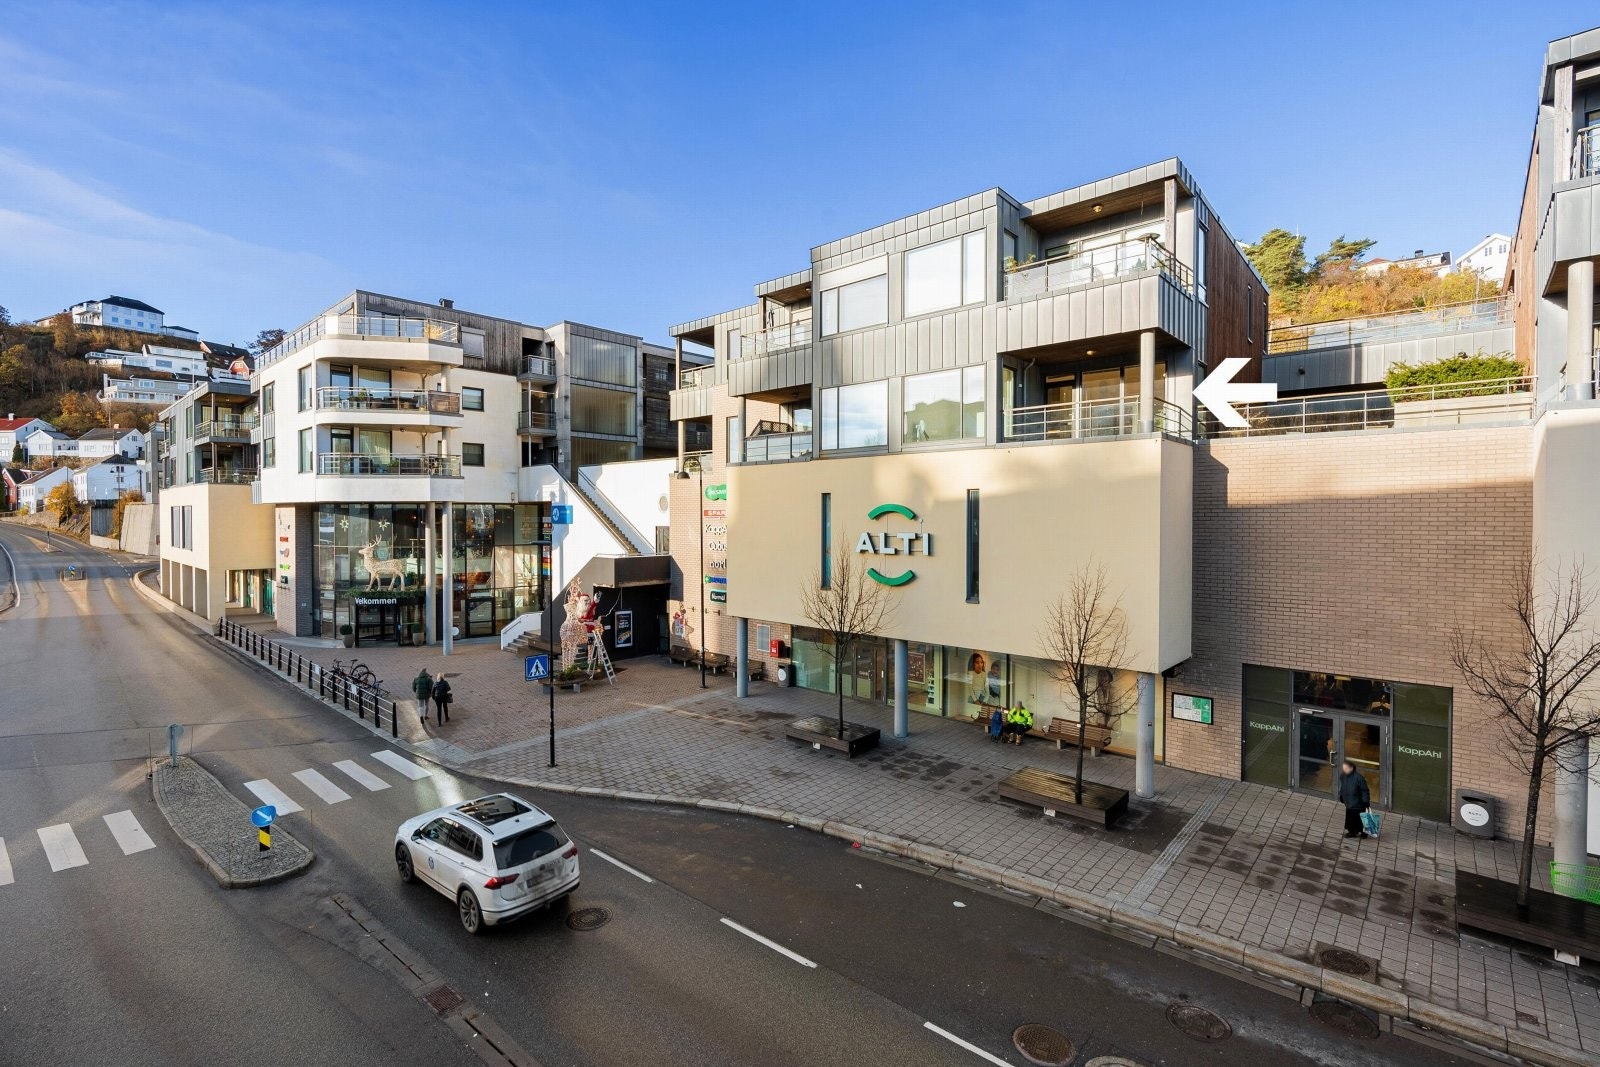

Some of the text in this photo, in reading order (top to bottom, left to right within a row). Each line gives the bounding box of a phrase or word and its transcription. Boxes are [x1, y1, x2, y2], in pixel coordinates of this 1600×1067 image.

[855, 531, 931, 556] ALTI
[355, 597, 397, 605] Velkommen
[1249, 720, 1285, 732] KappAhl
[1398, 745, 1442, 759] KappAhl
